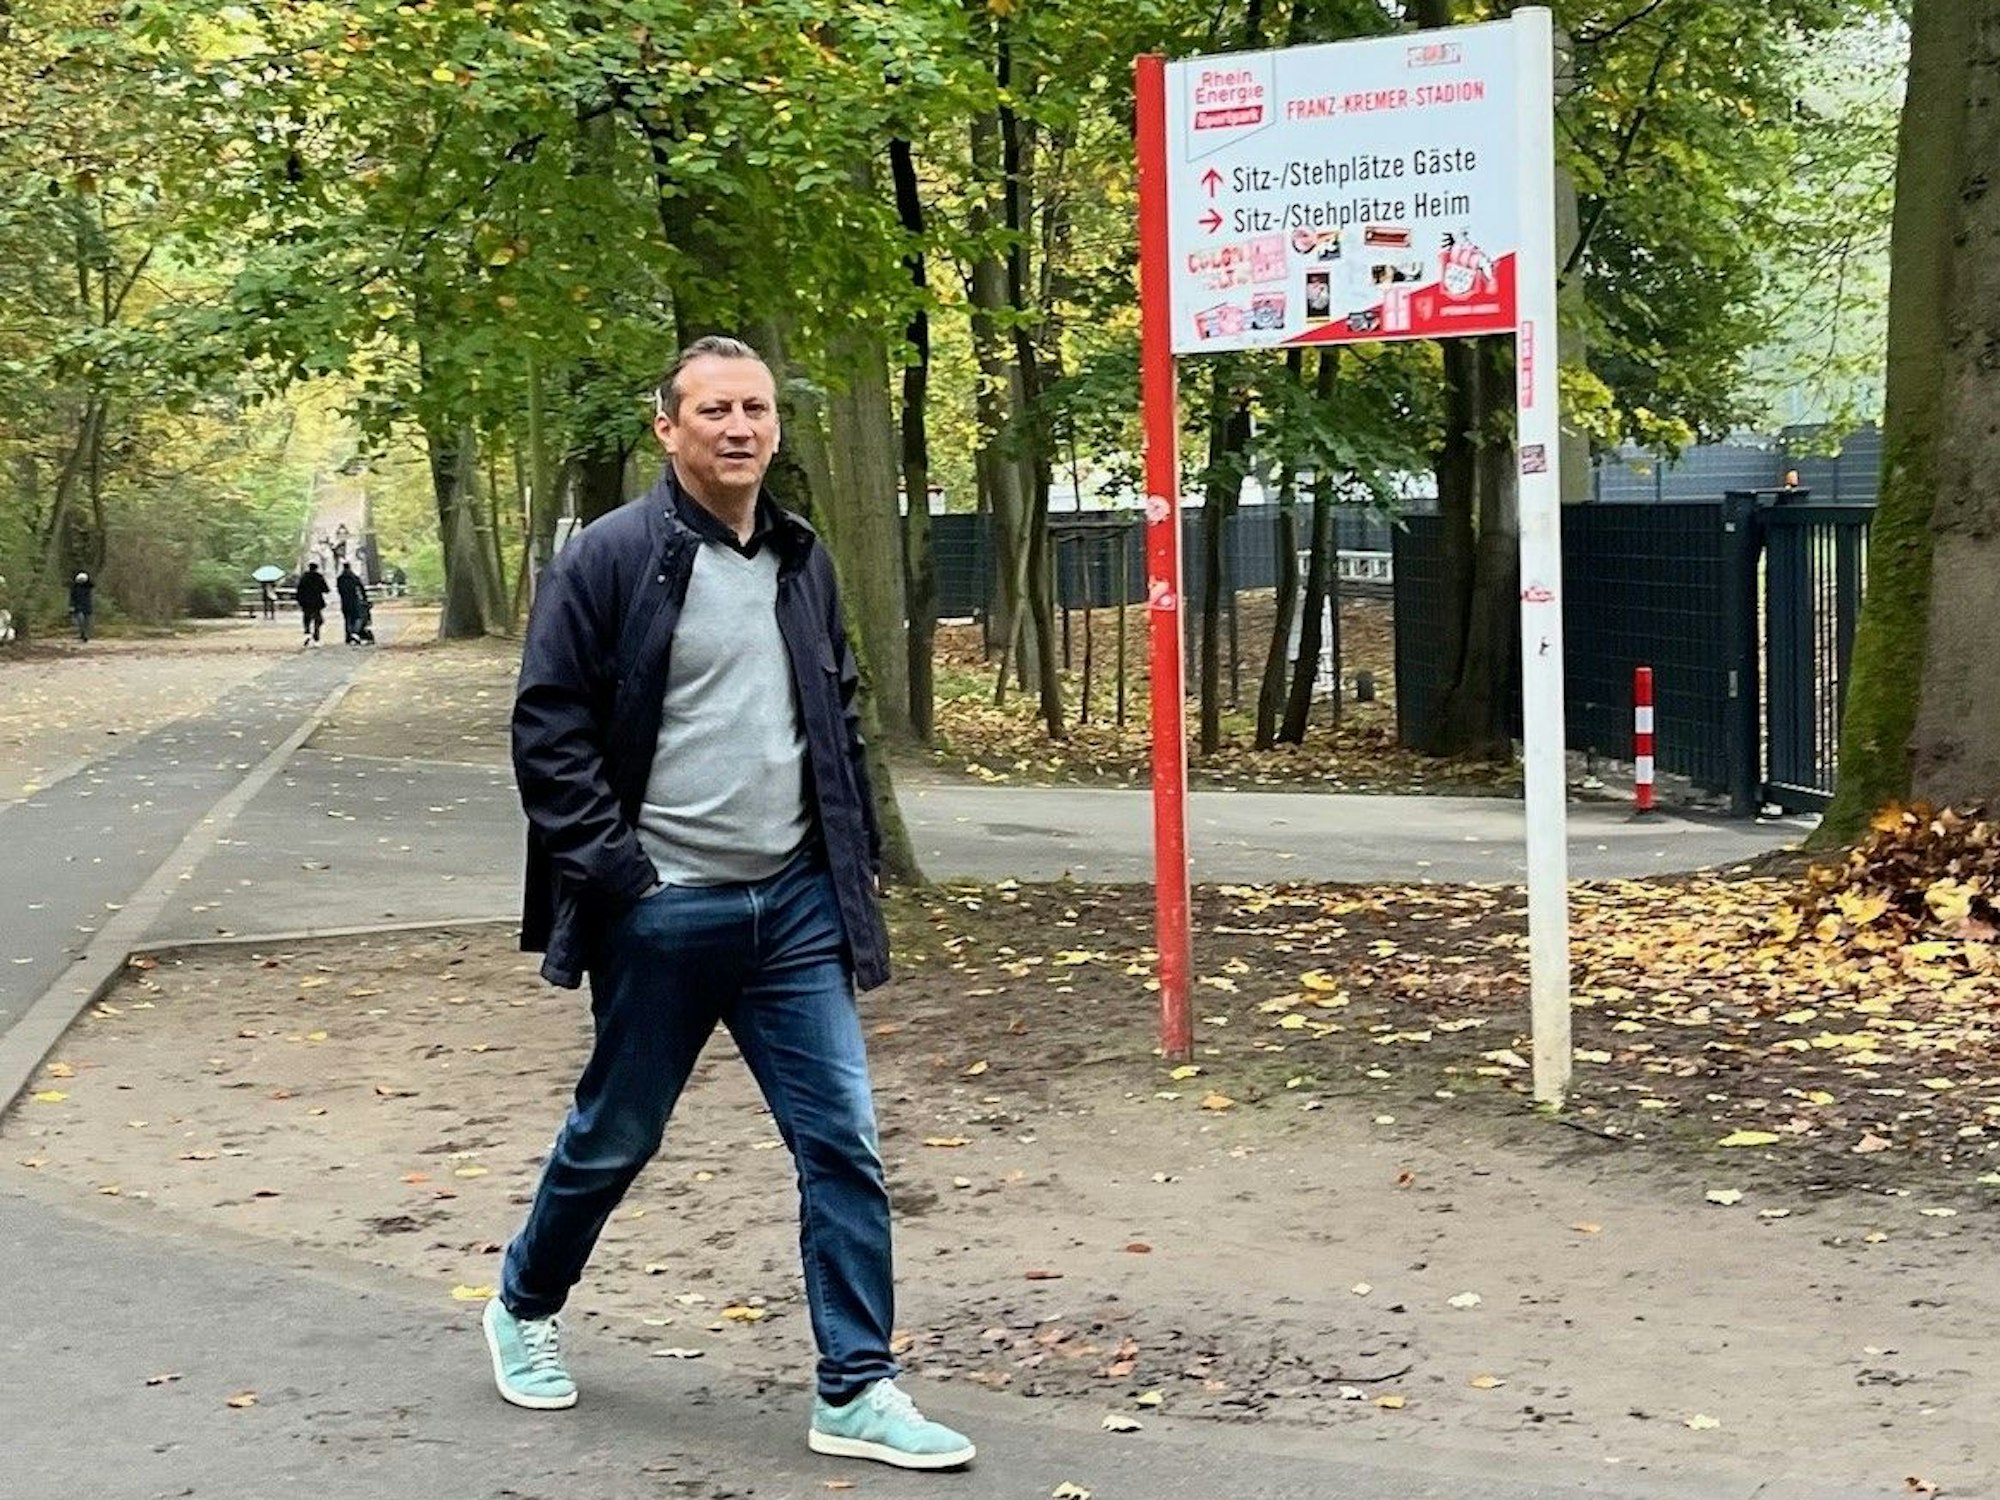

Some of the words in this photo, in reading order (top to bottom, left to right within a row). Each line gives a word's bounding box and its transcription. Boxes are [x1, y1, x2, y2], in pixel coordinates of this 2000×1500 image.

[1195, 85, 1264, 104] Energie
[1201, 70, 1253, 87] Rhein
[1287, 80, 1485, 121] FRANZ-KREMER-STADION
[1232, 154, 1405, 193] Sitz-/Stehplätze
[1413, 147, 1476, 176] Gäste
[1234, 197, 1406, 233] Sitz-/Stehplätze
[1414, 189, 1470, 219] Heim
